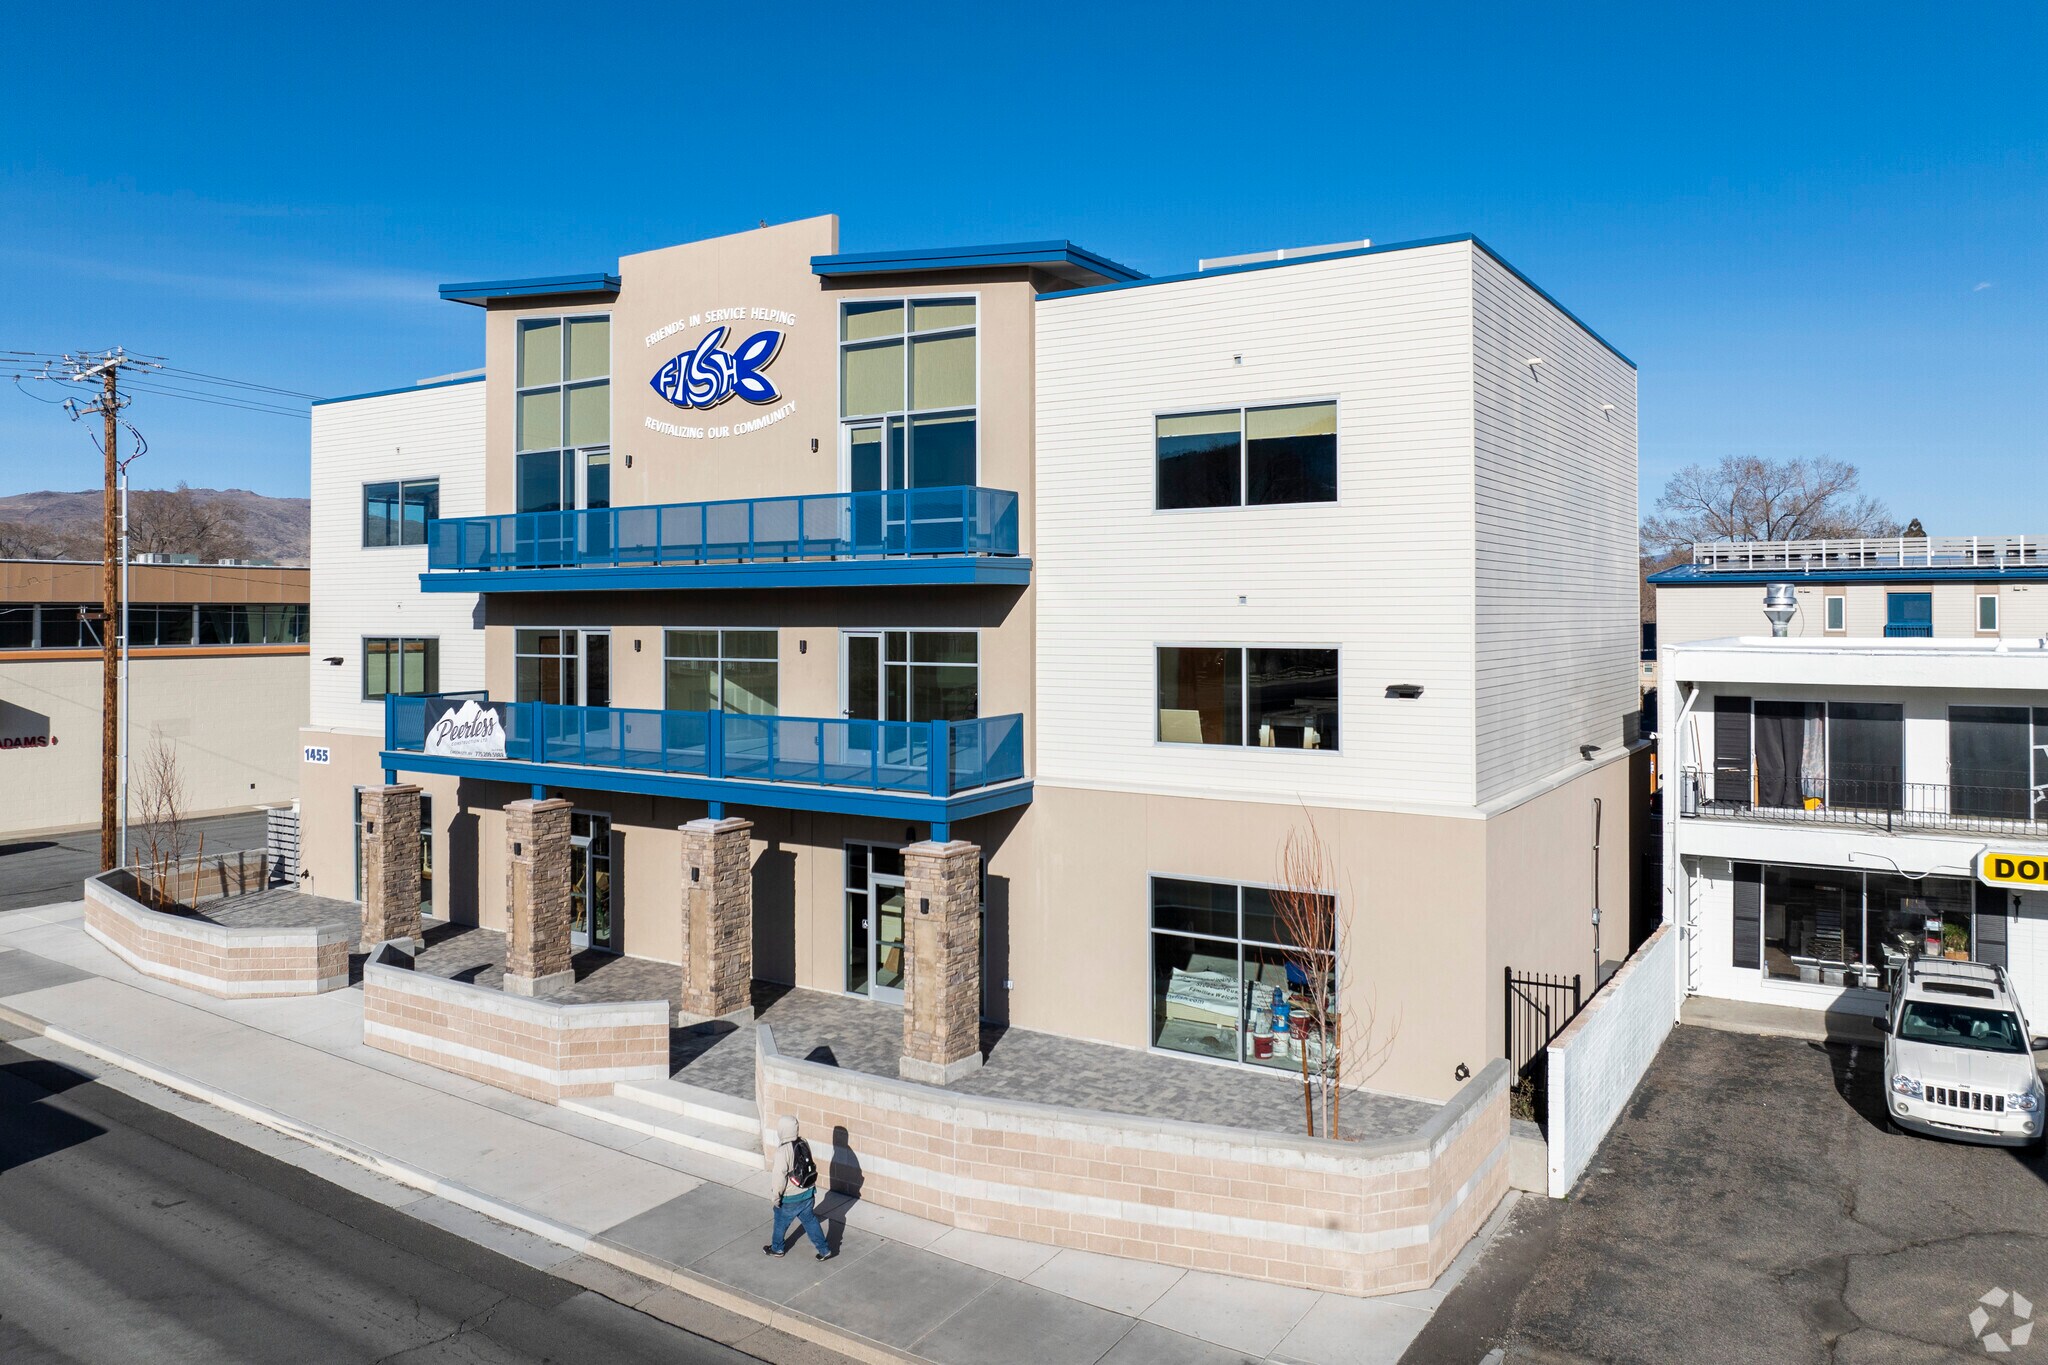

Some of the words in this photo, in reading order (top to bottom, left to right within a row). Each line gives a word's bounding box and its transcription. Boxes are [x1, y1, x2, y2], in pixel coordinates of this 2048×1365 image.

[645, 319, 685, 347] FRIENDS
[689, 313, 701, 327] IN
[705, 307, 746, 323] SERVICE
[750, 307, 796, 326] HELPING
[645, 416, 703, 439] REVITALIZING
[708, 426, 729, 439] OUR
[734, 400, 796, 436] COMMUNITY
[437, 710, 497, 746] Peerless
[305, 748, 328, 762] 1455
[1995, 858, 2048, 881] DO
